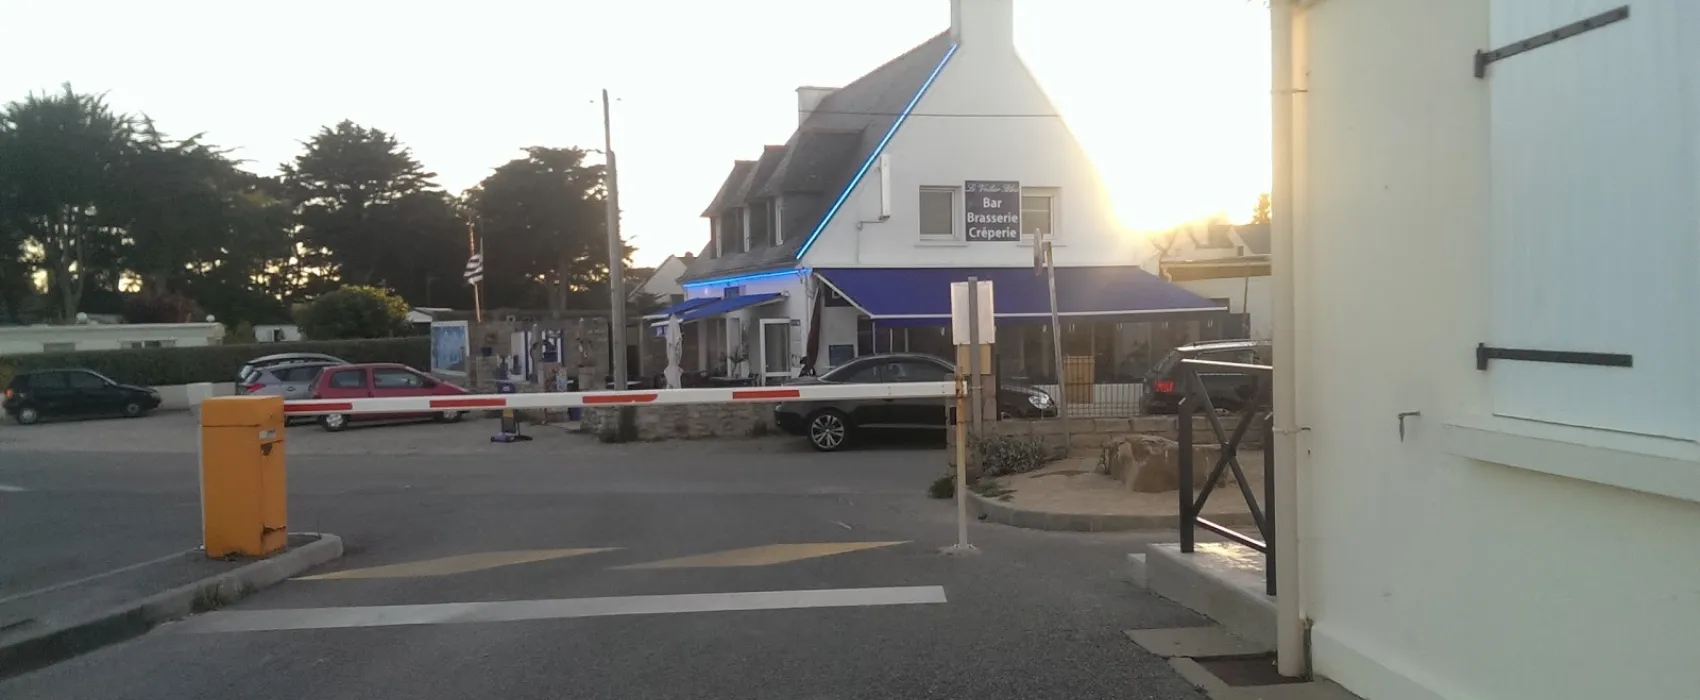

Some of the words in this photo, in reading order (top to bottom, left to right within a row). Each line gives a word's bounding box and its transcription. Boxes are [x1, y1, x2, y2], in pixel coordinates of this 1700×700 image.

[983, 197, 1002, 208] Bar
[967, 212, 1018, 223] Brasserie
[968, 227, 1016, 240] Crêperie
